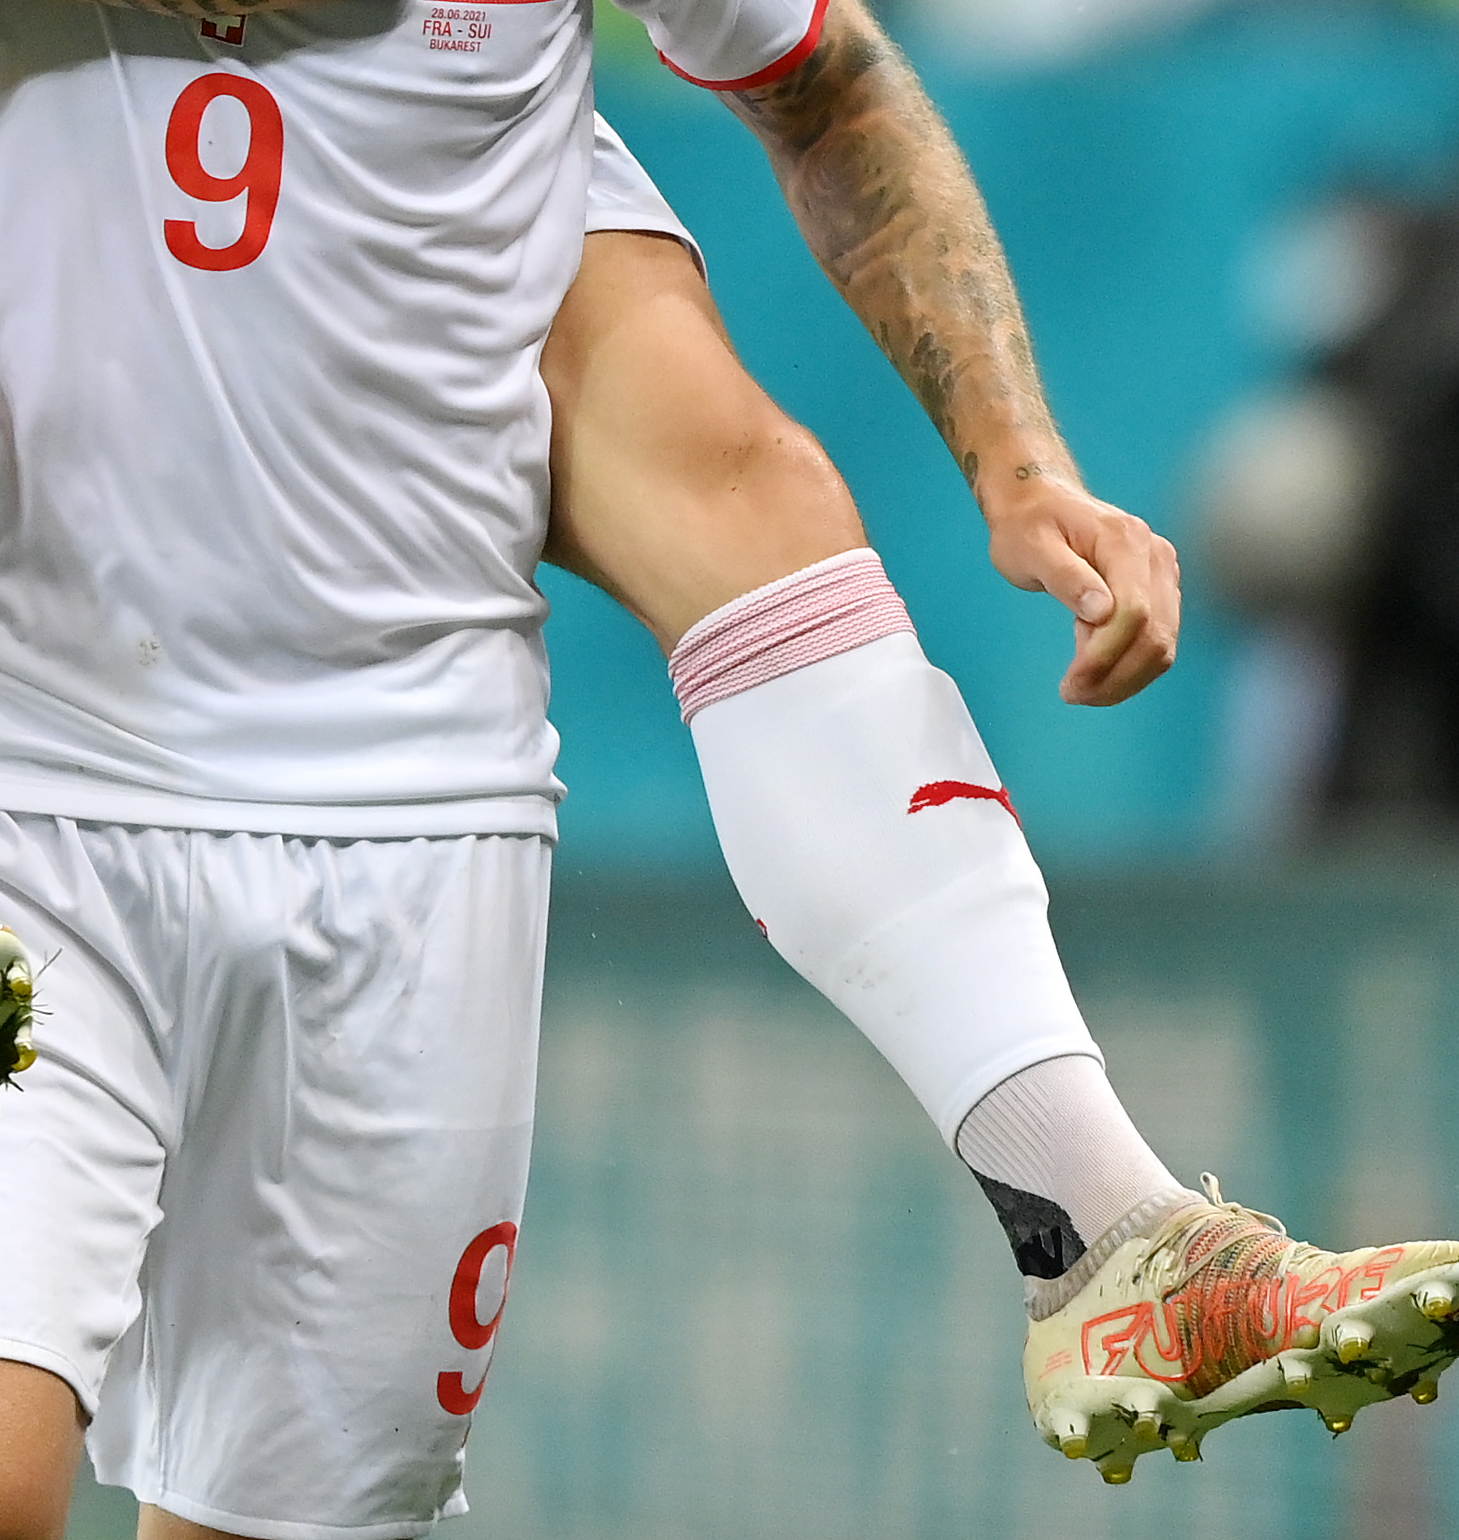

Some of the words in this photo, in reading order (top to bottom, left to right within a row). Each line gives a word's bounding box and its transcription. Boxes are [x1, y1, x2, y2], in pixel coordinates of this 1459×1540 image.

[431, 7, 486, 21] 28.06.2021
[422, 20, 452, 37] FRA
[468, 23, 492, 39] SUI
[429, 39, 481, 52] BUKAREST
[163, 72, 284, 272] 9
[437, 1221, 517, 1415] 9
